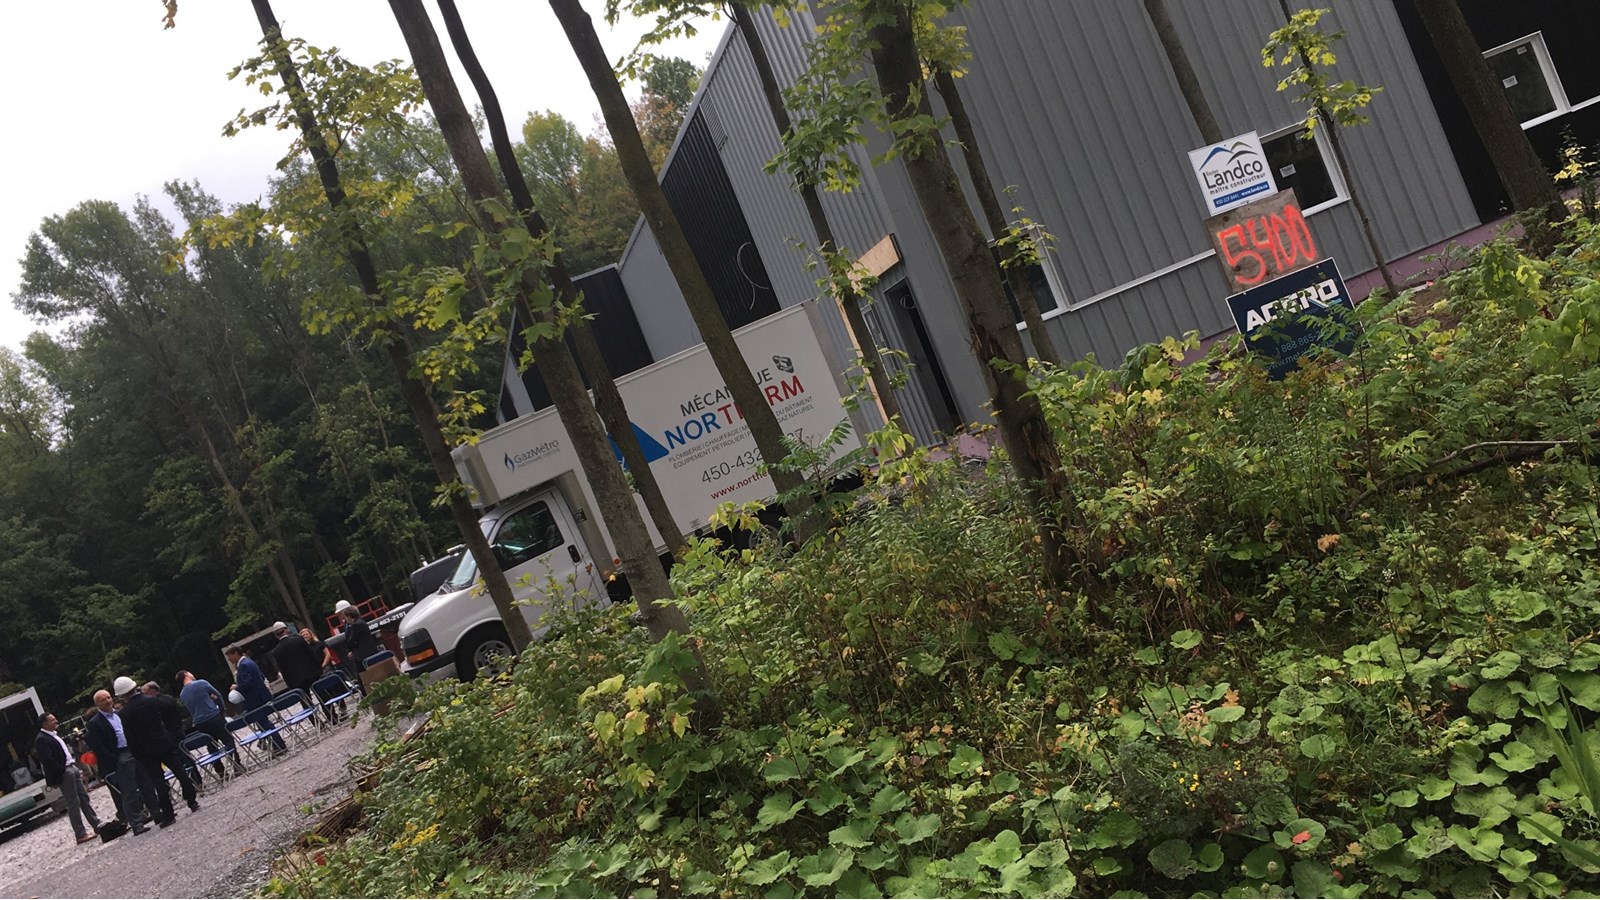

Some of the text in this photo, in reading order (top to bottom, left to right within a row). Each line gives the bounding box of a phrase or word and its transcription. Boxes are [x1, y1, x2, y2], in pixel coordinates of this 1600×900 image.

[1203, 160, 1263, 189] Landco
[1230, 172, 1266, 189] constructeur
[1216, 204, 1317, 284] 5400
[1281, 341, 1298, 353] 888
[664, 375, 805, 450] NORTRM
[680, 368, 773, 417] MÉCAUE
[668, 444, 702, 463] PLOMBERIE
[704, 427, 739, 447] CHAUFFAGE
[775, 408, 785, 417] DU
[785, 396, 813, 414] BÂTIMENT
[673, 449, 711, 470] ÉQUIPEMENT
[711, 433, 745, 455] PÉTROLIER
[788, 404, 815, 420] NATUREL
[513, 439, 559, 464] GazMétro
[710, 469, 769, 500] www.northe
